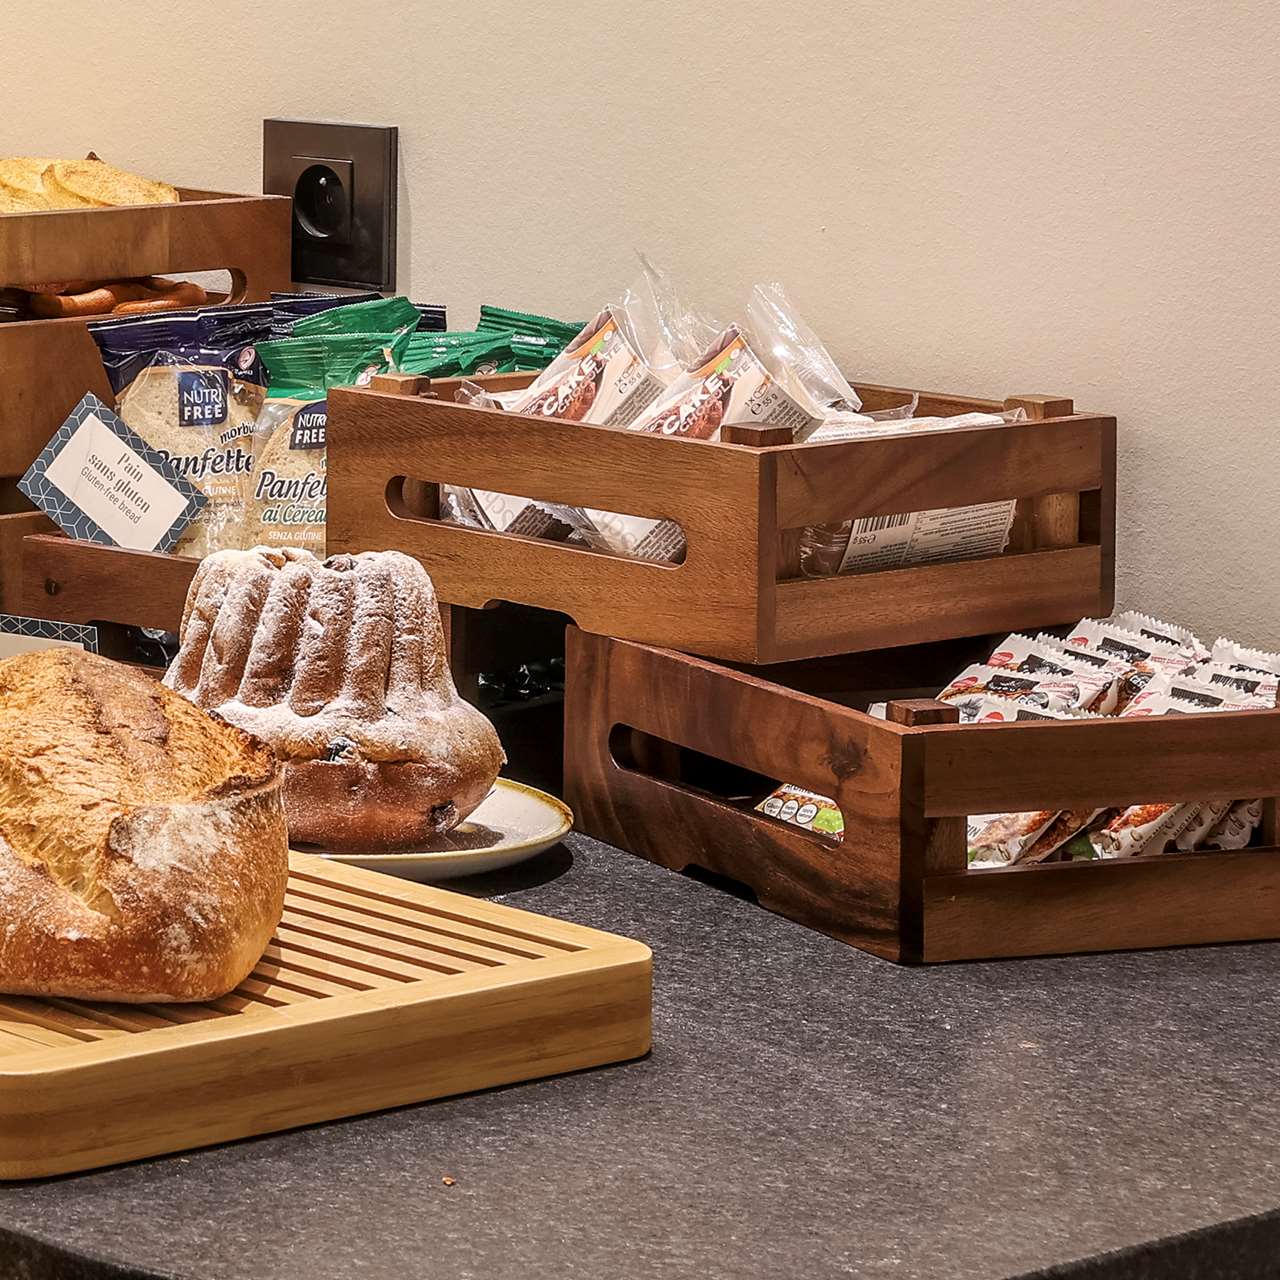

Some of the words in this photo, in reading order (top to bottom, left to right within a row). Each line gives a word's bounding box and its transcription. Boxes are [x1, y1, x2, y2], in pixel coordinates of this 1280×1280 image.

[183, 388, 223, 404] NUTRI
[542, 354, 597, 416] CAKE
[183, 406, 223, 421] FREE
[662, 372, 724, 435] CAKE
[295, 428, 326, 444] FREE
[117, 452, 144, 482] Pain
[80, 466, 121, 505] Gluten-free
[117, 500, 142, 524] bread
[88, 454, 117, 481] sans
[113, 478, 151, 513] gluten
[262, 504, 281, 522] ai
[268, 531, 293, 540] SENZA
[294, 531, 322, 541] GLUTINE
